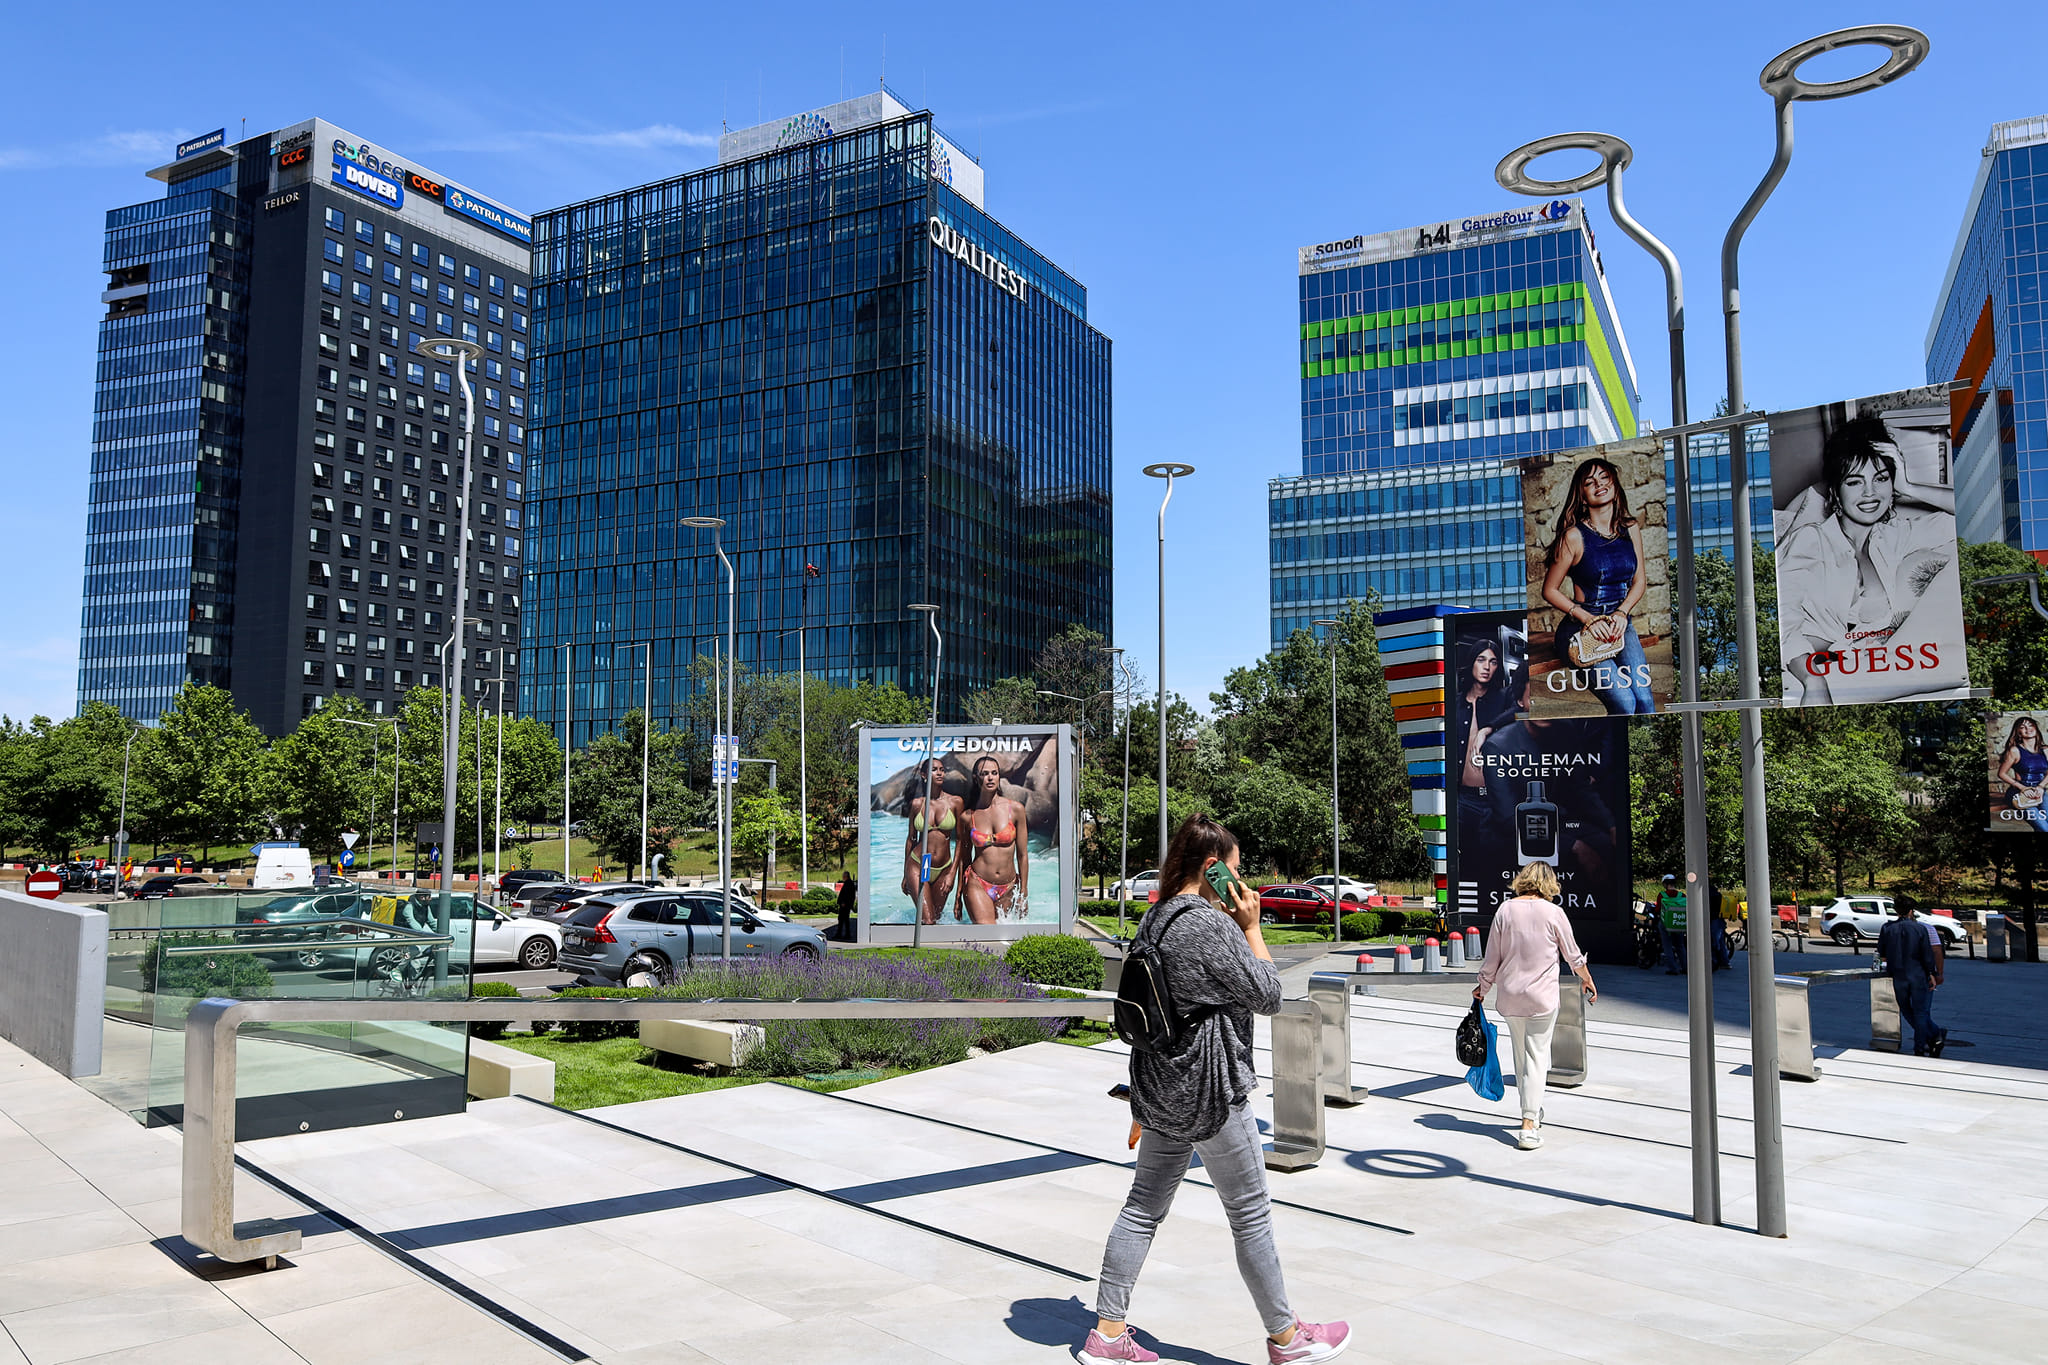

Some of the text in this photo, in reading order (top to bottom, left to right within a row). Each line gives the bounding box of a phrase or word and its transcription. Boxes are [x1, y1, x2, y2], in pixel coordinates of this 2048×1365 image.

[186, 133, 222, 153] PATRIA BANK
[281, 148, 305, 166] CCC
[333, 139, 406, 181] coface
[346, 165, 397, 201] DOVER
[411, 175, 440, 196] CCC
[264, 191, 300, 210] TEILOR
[466, 200, 532, 238] PATRIA BANK
[1461, 210, 1534, 232] Carrefour
[1315, 235, 1364, 256] sanofi
[929, 215, 1028, 303] QUALITEST
[1845, 629, 1894, 640] GEORGINA
[1805, 642, 1940, 677] GUESS
[1546, 664, 1652, 693] GUESS
[897, 736, 1033, 752] CALZEDONIA
[1472, 753, 1601, 767] GENTLEMAN
[1497, 767, 1574, 778] SOCIETY
[1502, 870, 1575, 881] GIHY
[1489, 890, 1597, 909] SEORA
